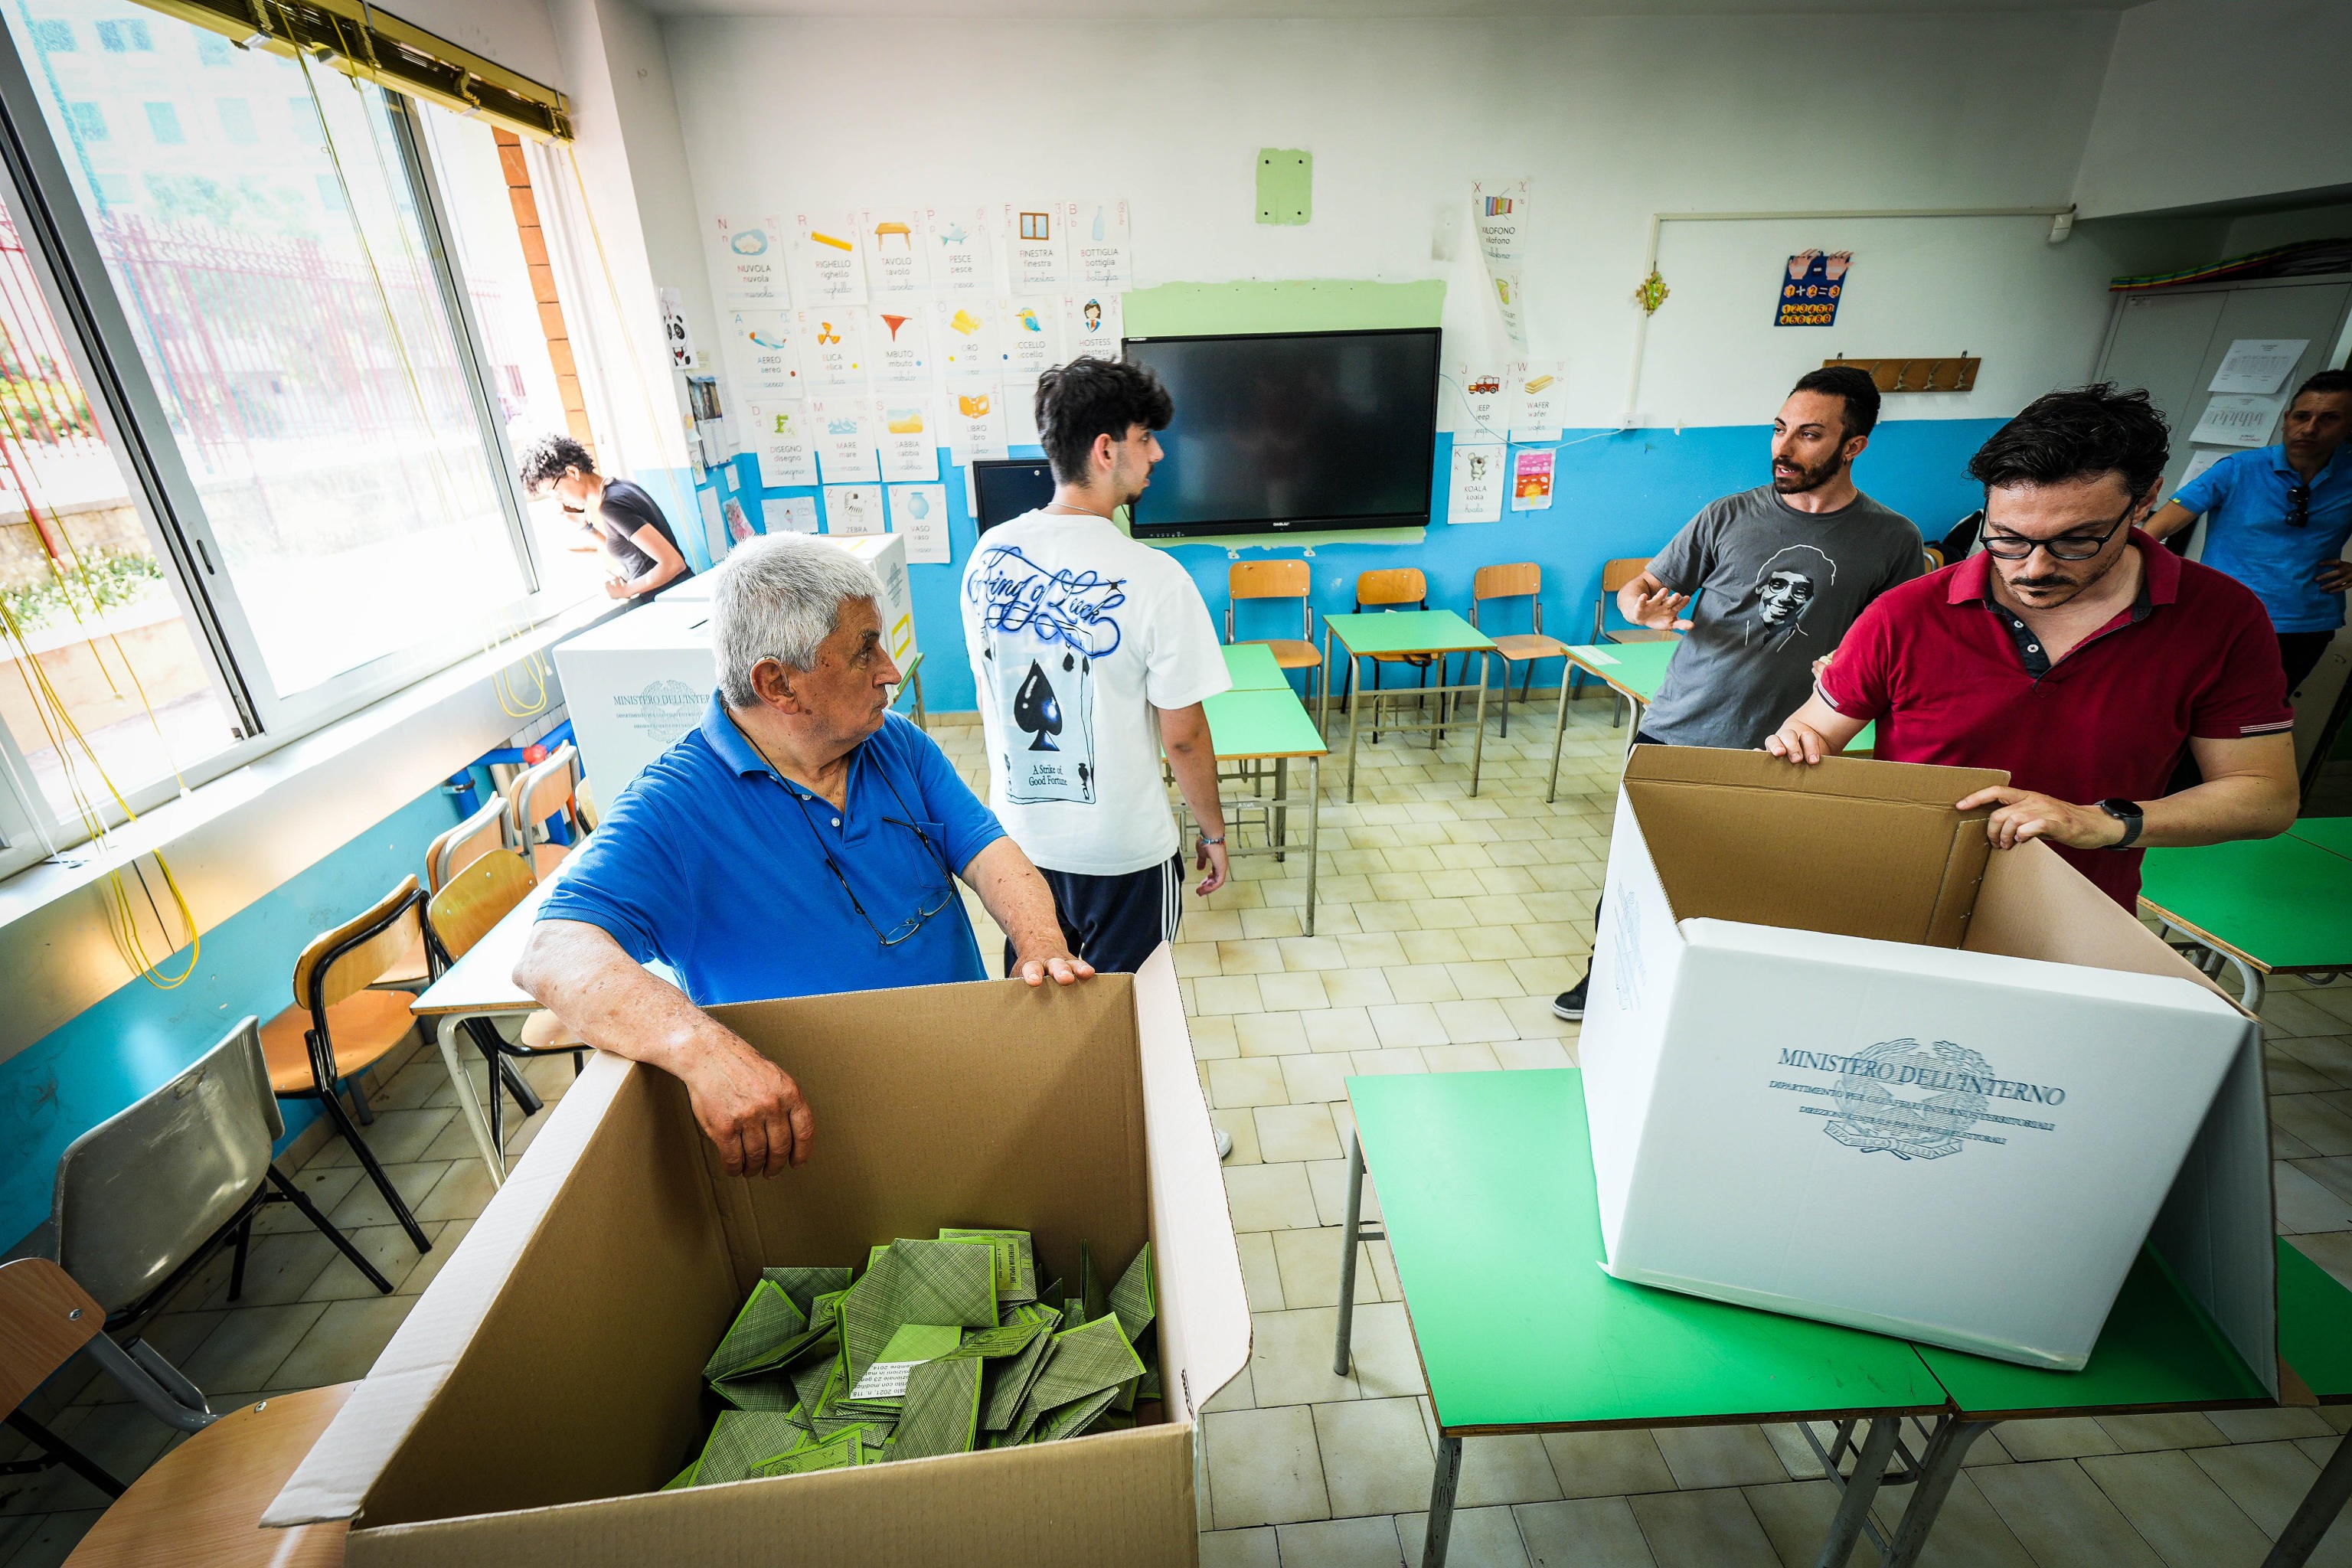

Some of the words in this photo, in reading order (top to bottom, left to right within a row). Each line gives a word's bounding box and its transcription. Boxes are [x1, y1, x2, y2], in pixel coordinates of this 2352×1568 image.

[1474, 181, 1481, 192] X
[1069, 204, 1077, 215] B
[798, 214, 807, 226] R
[863, 212, 870, 222] T
[926, 210, 936, 220] P
[717, 217, 727, 230] N
[1481, 227, 1515, 235] XILOFONO
[1485, 236, 1511, 244] xilofono
[1019, 249, 1054, 258] FINESTRA
[1080, 247, 1119, 257] BOTTIGLIA
[882, 256, 912, 266] TAVOLO
[949, 254, 972, 263] PESCE
[737, 263, 772, 273] NUVOLA
[815, 260, 851, 269] RIGHELLO
[1024, 260, 1052, 268] finestra
[1085, 259, 1116, 269] bottiglia
[821, 270, 849, 281] righello
[950, 266, 972, 275] pesce
[743, 275, 769, 283] nuvola
[735, 313, 743, 324] A
[962, 344, 978, 352] ORO
[1079, 338, 1110, 348] HOSTESS
[757, 355, 782, 364] AEREO
[822, 353, 843, 362] ELICA
[1462, 364, 1468, 374] J
[1518, 362, 1527, 372] W
[752, 405, 760, 416] D
[813, 401, 824, 413] M
[876, 400, 884, 411] S
[1476, 404, 1490, 413] JEEP
[1527, 401, 1550, 410] WAFER
[1527, 410, 1547, 418] wafer
[966, 424, 987, 433] LIBRO
[769, 445, 802, 454] DISEGNO
[836, 441, 857, 449] MARE
[894, 441, 920, 449] SABBIA
[1454, 448, 1462, 459] K
[773, 454, 802, 464] disegno
[827, 488, 833, 498] Z
[1464, 485, 1487, 493] KOALA
[613, 695, 660, 706] MINISTERO
[1033, 765, 1039, 775] A
[1039, 764, 1056, 775] Strike
[1057, 765, 1063, 775] of
[1028, 774, 1047, 786] Good
[1777, 1047, 1896, 1080] MINISTERO
[1898, 1065, 2066, 1106] DELL'INTERNO
[1768, 1080, 1844, 1098] DIPARTIMENTO
